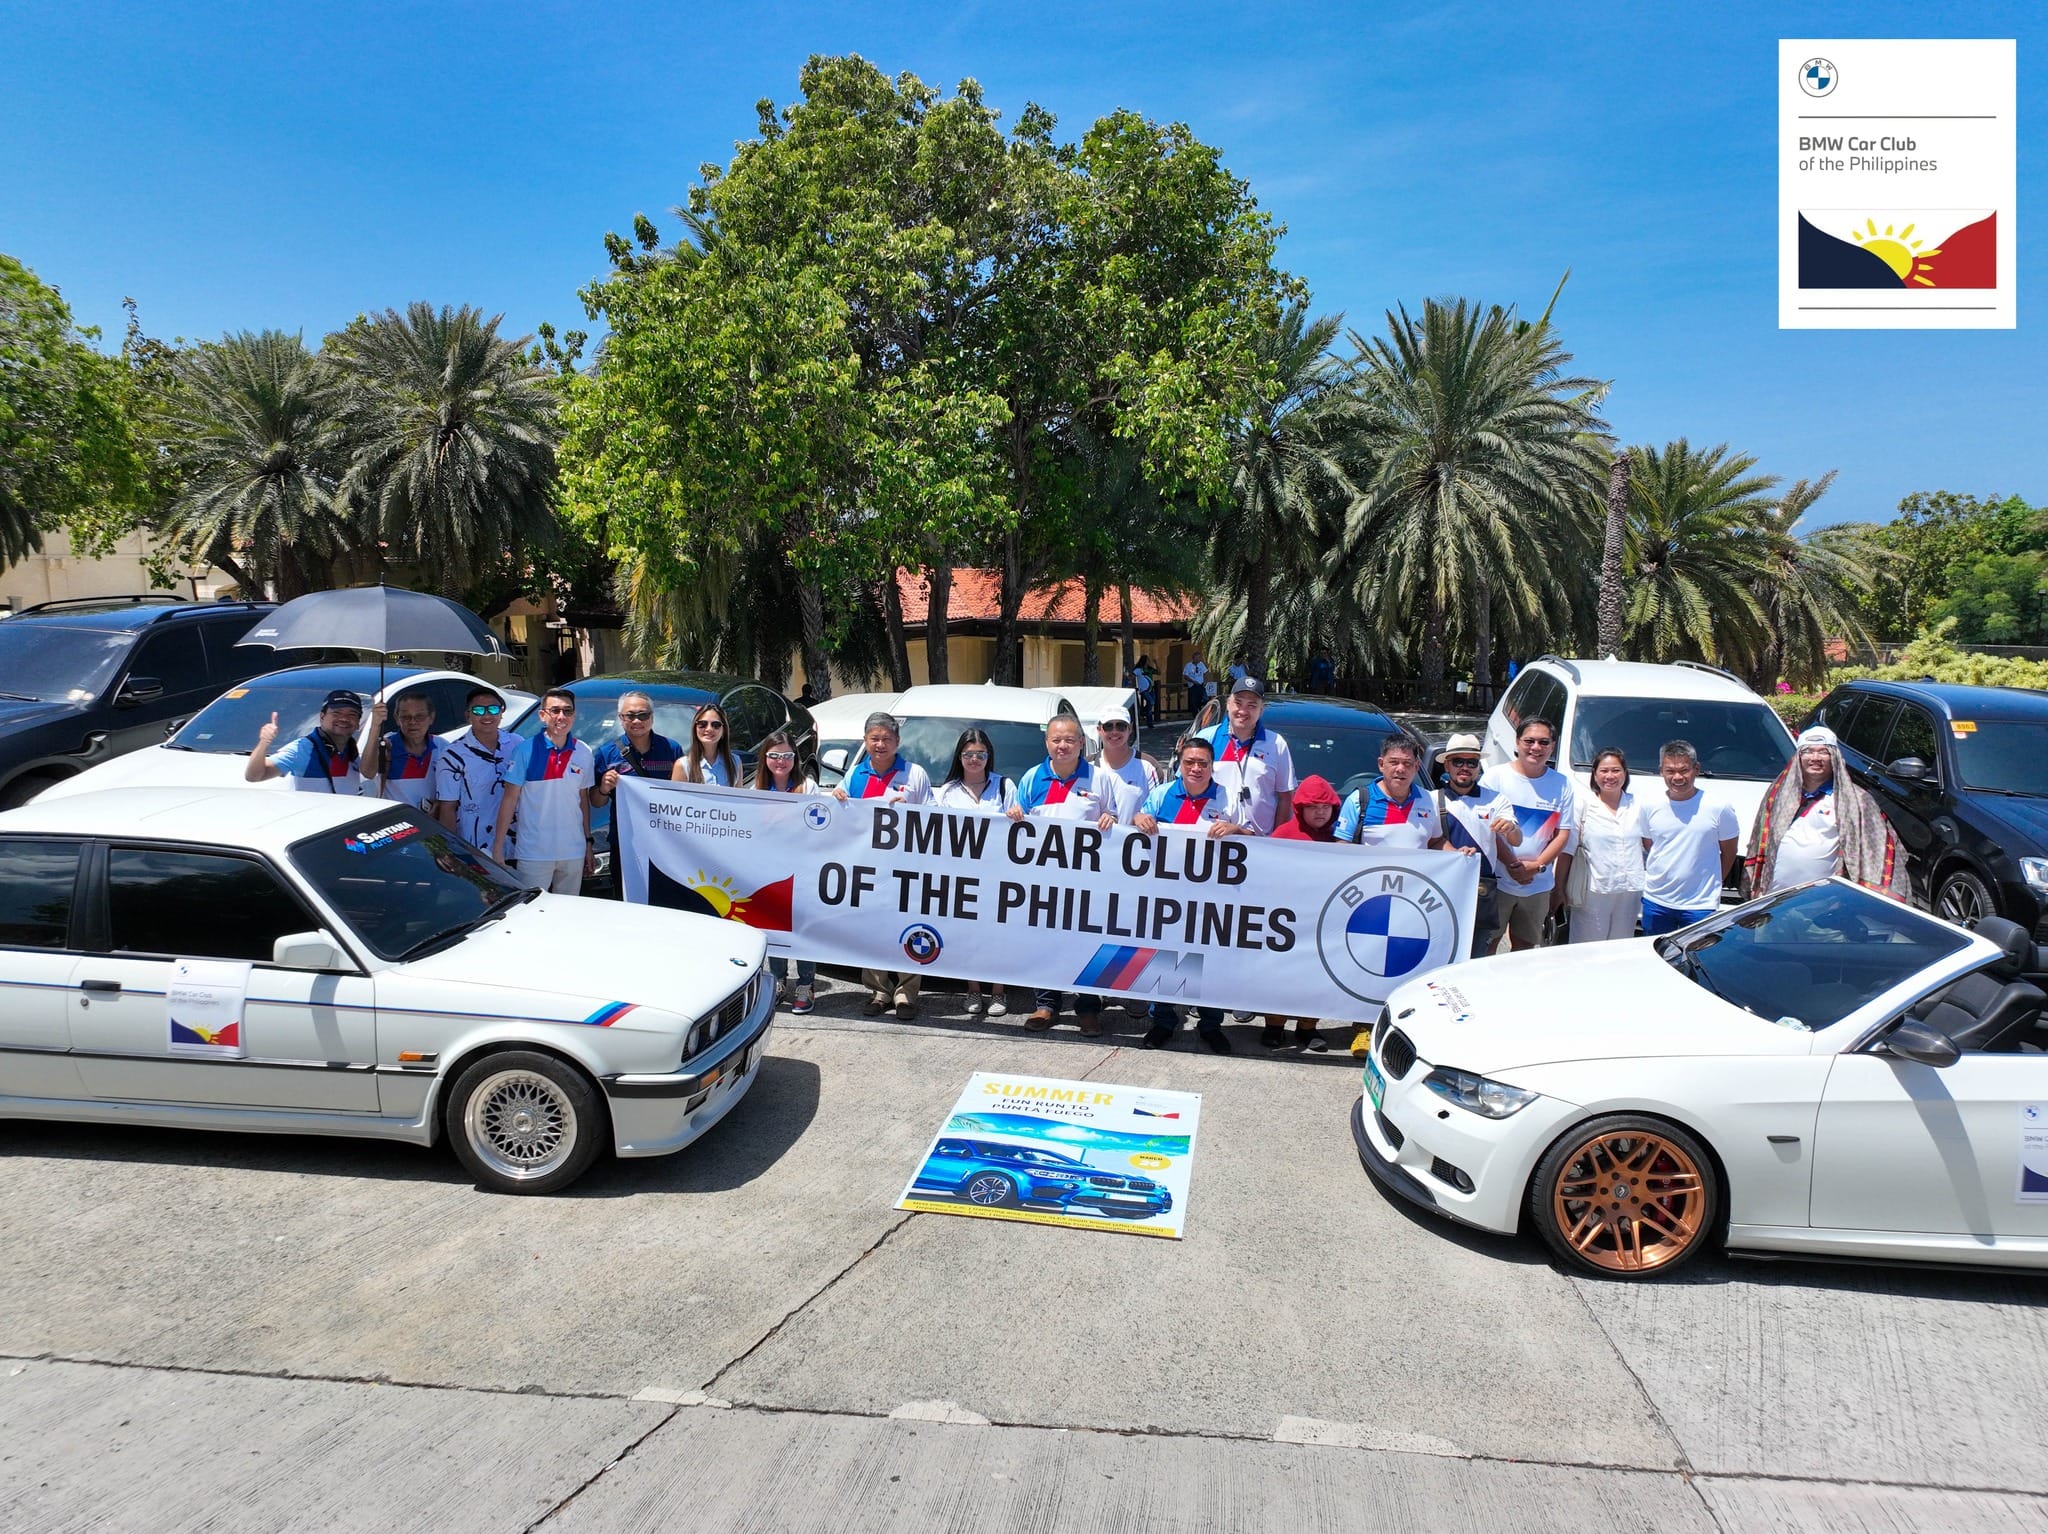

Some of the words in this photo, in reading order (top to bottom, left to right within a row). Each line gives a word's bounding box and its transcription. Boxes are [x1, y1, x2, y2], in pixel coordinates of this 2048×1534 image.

[649, 803, 682, 817] BMW
[685, 807, 706, 819] Car
[709, 808, 737, 822] Club
[649, 818, 664, 829] of
[664, 819, 682, 832] the
[685, 822, 752, 840] Philippines
[872, 807, 990, 860] BMW
[1007, 821, 1102, 872] CAR
[1121, 832, 1248, 886] CLUB
[1340, 874, 1443, 914] BMW
[818, 862, 876, 908] OF
[892, 870, 980, 920] THE
[997, 881, 1296, 952] PHILLIPINES
[982, 1082, 1114, 1105] SUMMER
[991, 1103, 1040, 1113] PUNTA
[1035, 1101, 1065, 1109] RUN
